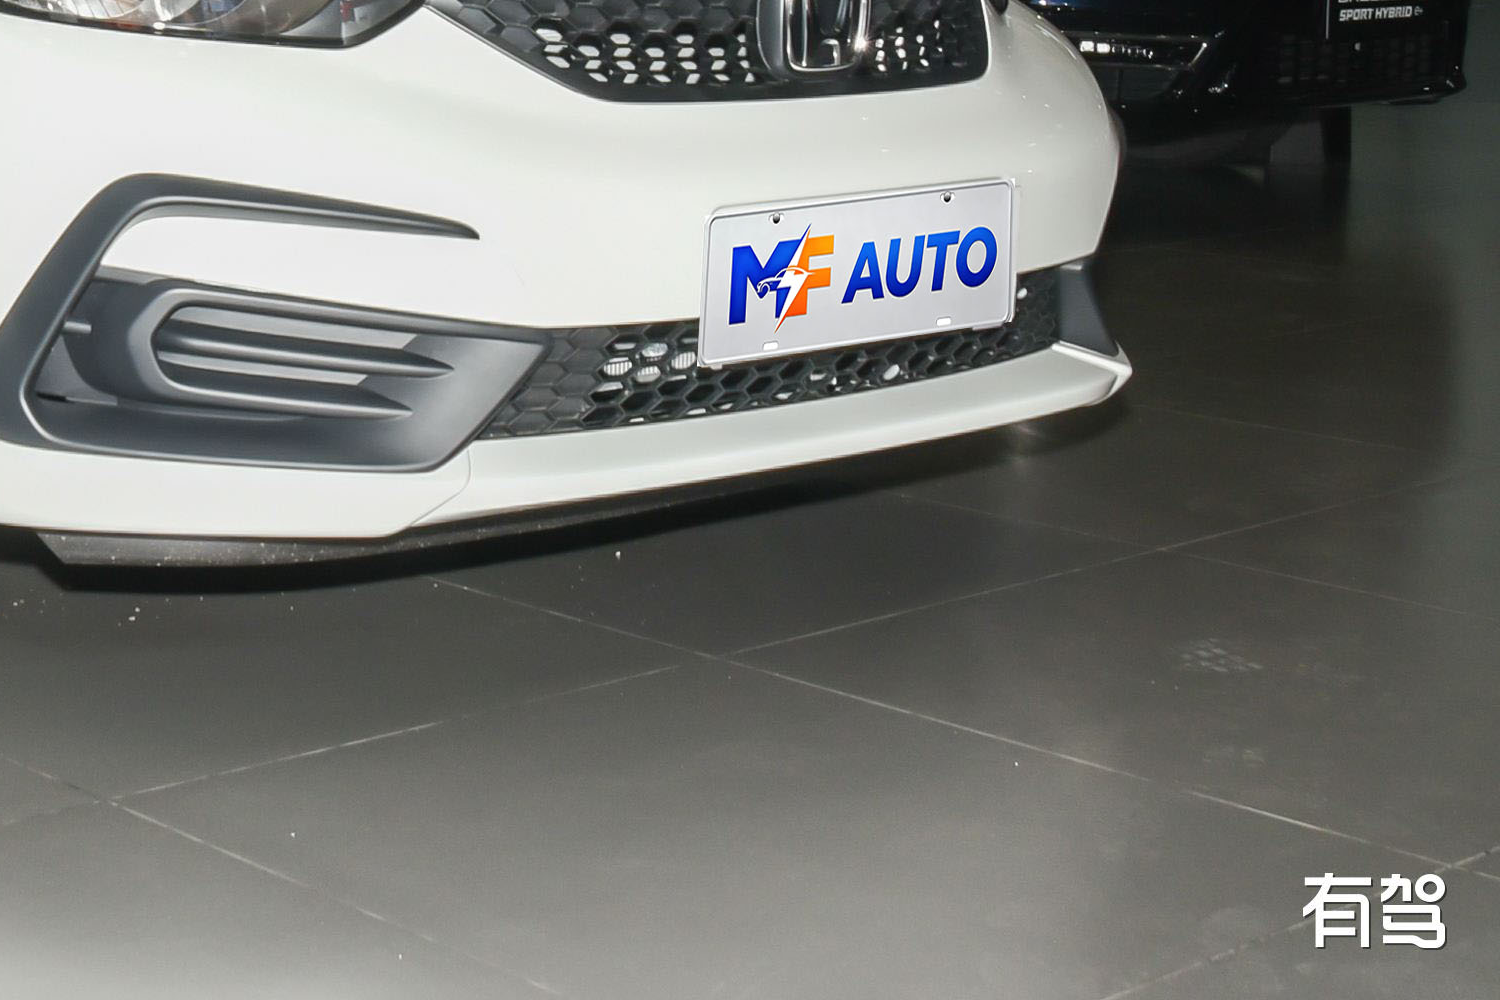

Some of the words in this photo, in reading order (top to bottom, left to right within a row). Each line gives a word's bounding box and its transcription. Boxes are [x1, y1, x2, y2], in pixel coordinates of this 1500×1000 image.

[1339, 8, 1374, 22] SPORT
[1375, 5, 1413, 19] HYBRID
[841, 226, 998, 304] AUTO
